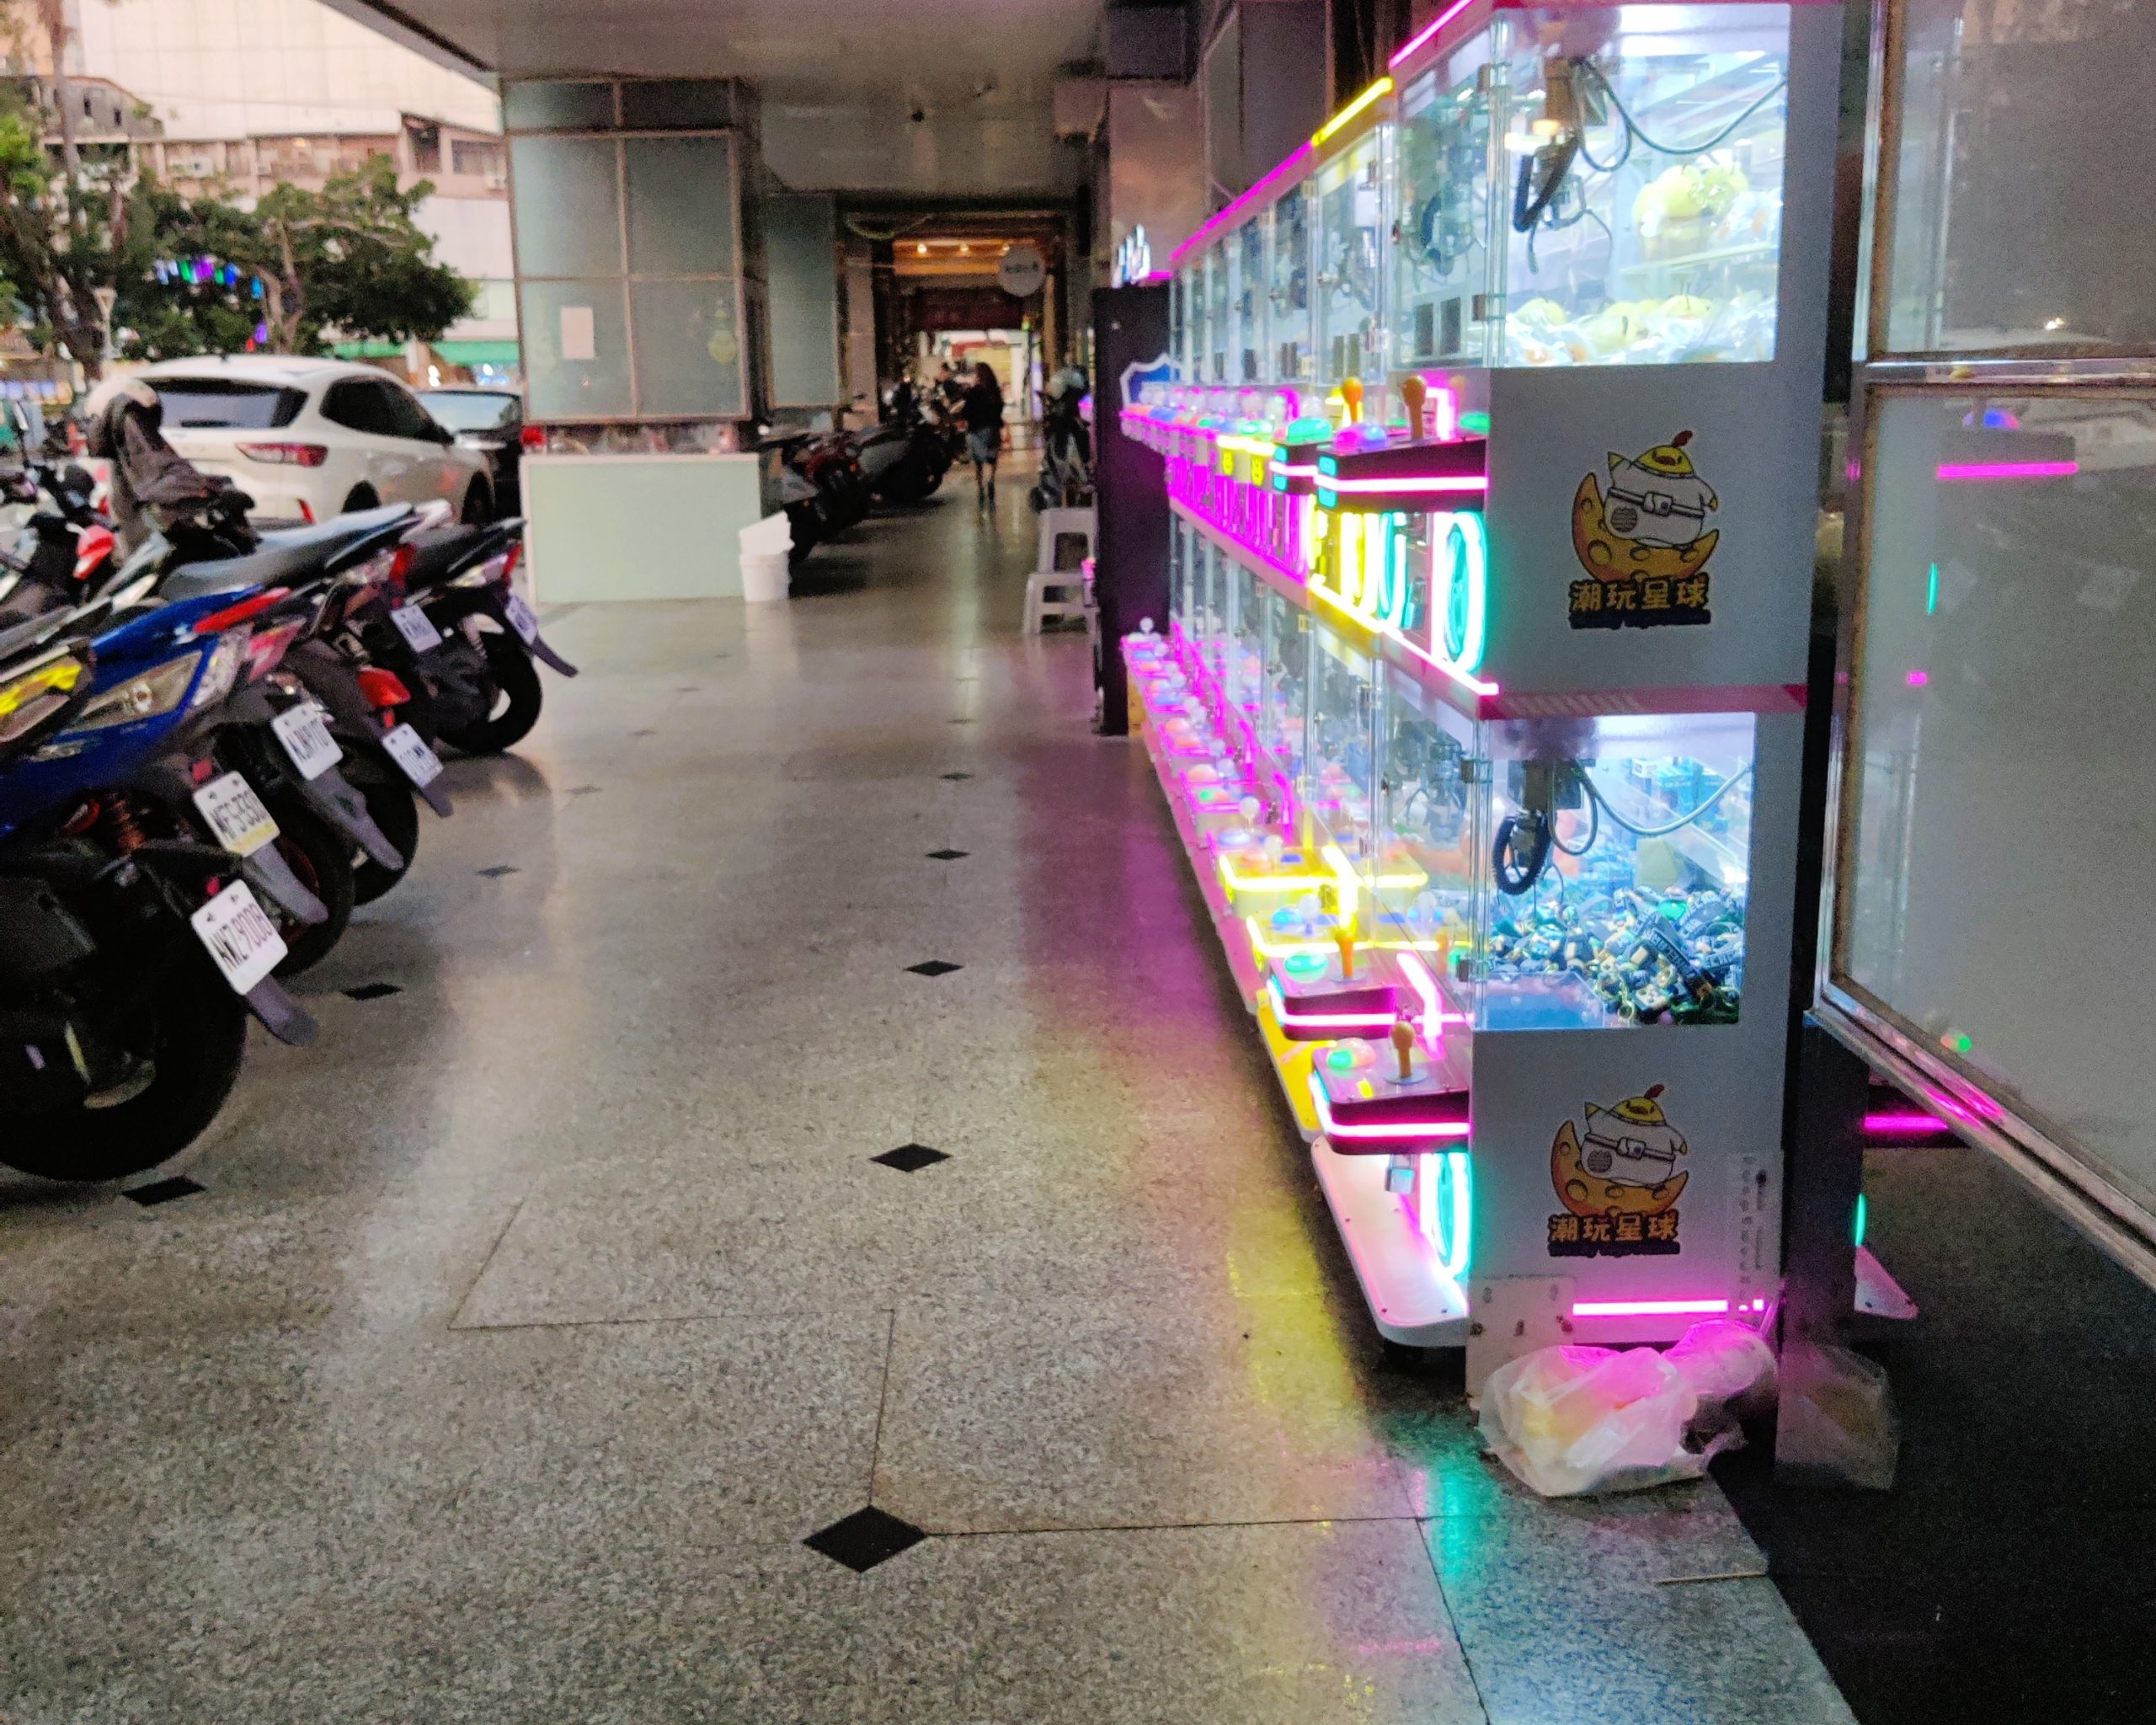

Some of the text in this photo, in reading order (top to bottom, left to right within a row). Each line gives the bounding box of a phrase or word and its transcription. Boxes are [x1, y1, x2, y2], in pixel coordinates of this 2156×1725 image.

[1571, 578, 1705, 612] 潮玩星球
[1550, 1215, 1674, 1242] 潮玩星球
